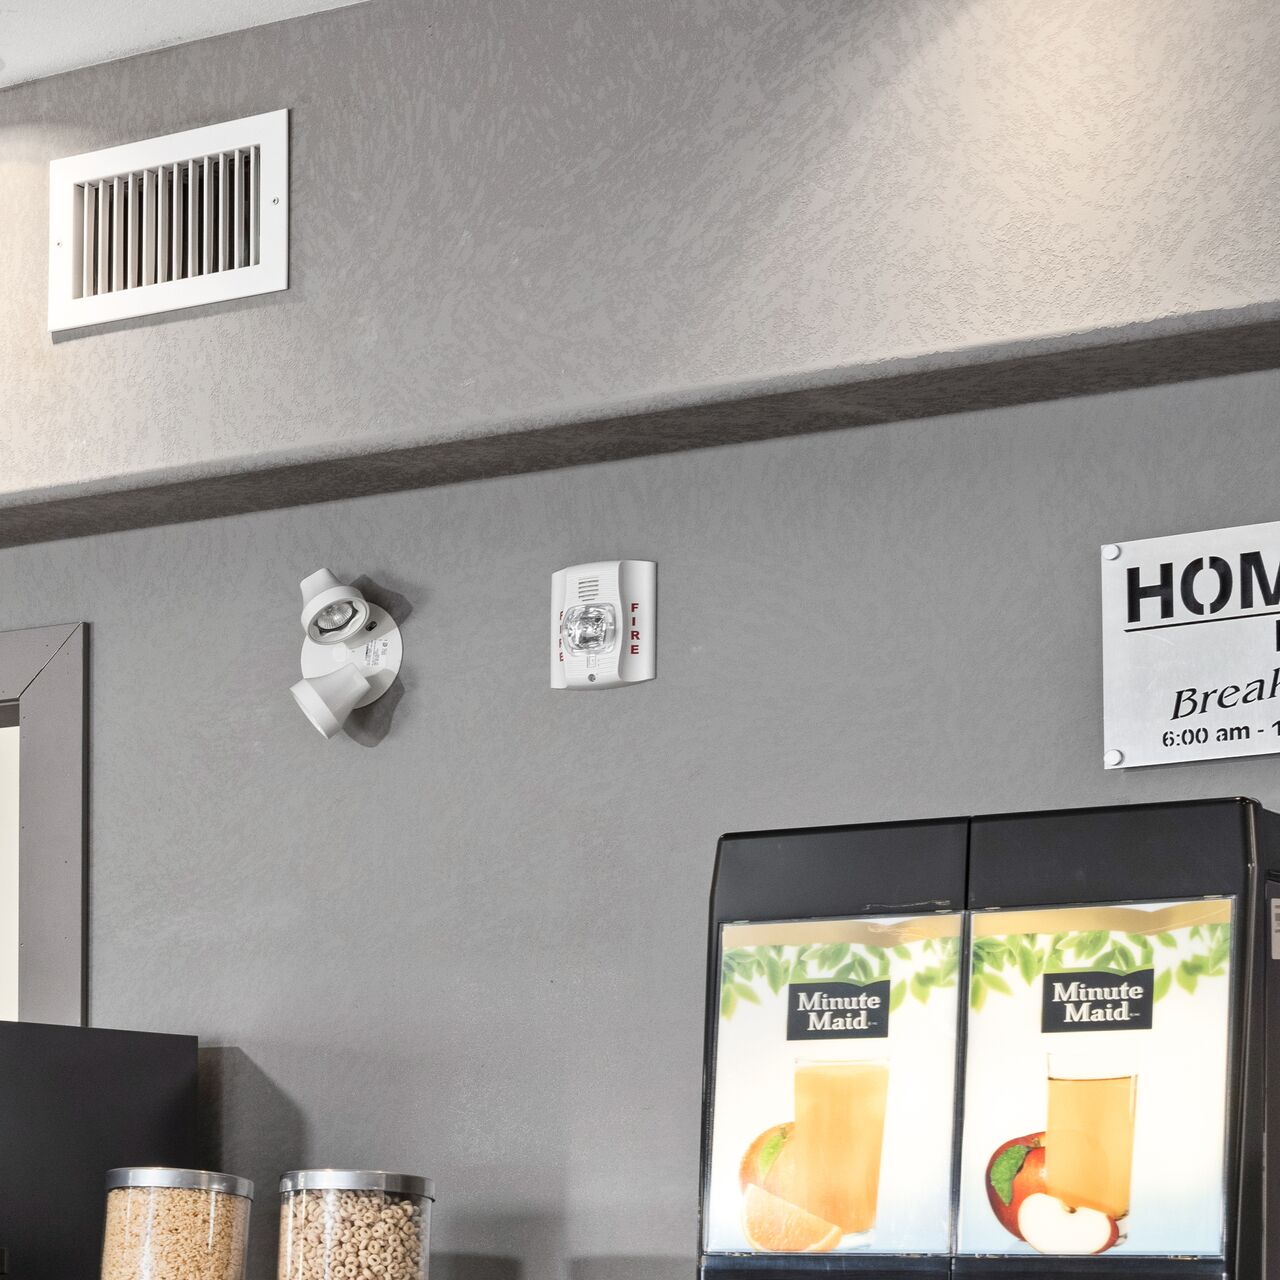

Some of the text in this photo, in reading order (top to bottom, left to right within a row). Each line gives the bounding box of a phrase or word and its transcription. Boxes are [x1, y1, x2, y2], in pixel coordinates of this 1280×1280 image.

[630, 603, 640, 654] FIRE
[1162, 726, 1209, 748] 6:00
[1216, 725, 1250, 742] am
[797, 991, 881, 1011] Minute
[1052, 981, 1144, 1002] Minute
[807, 1010, 869, 1031] Maid
[1063, 1001, 1131, 1022] Maid
